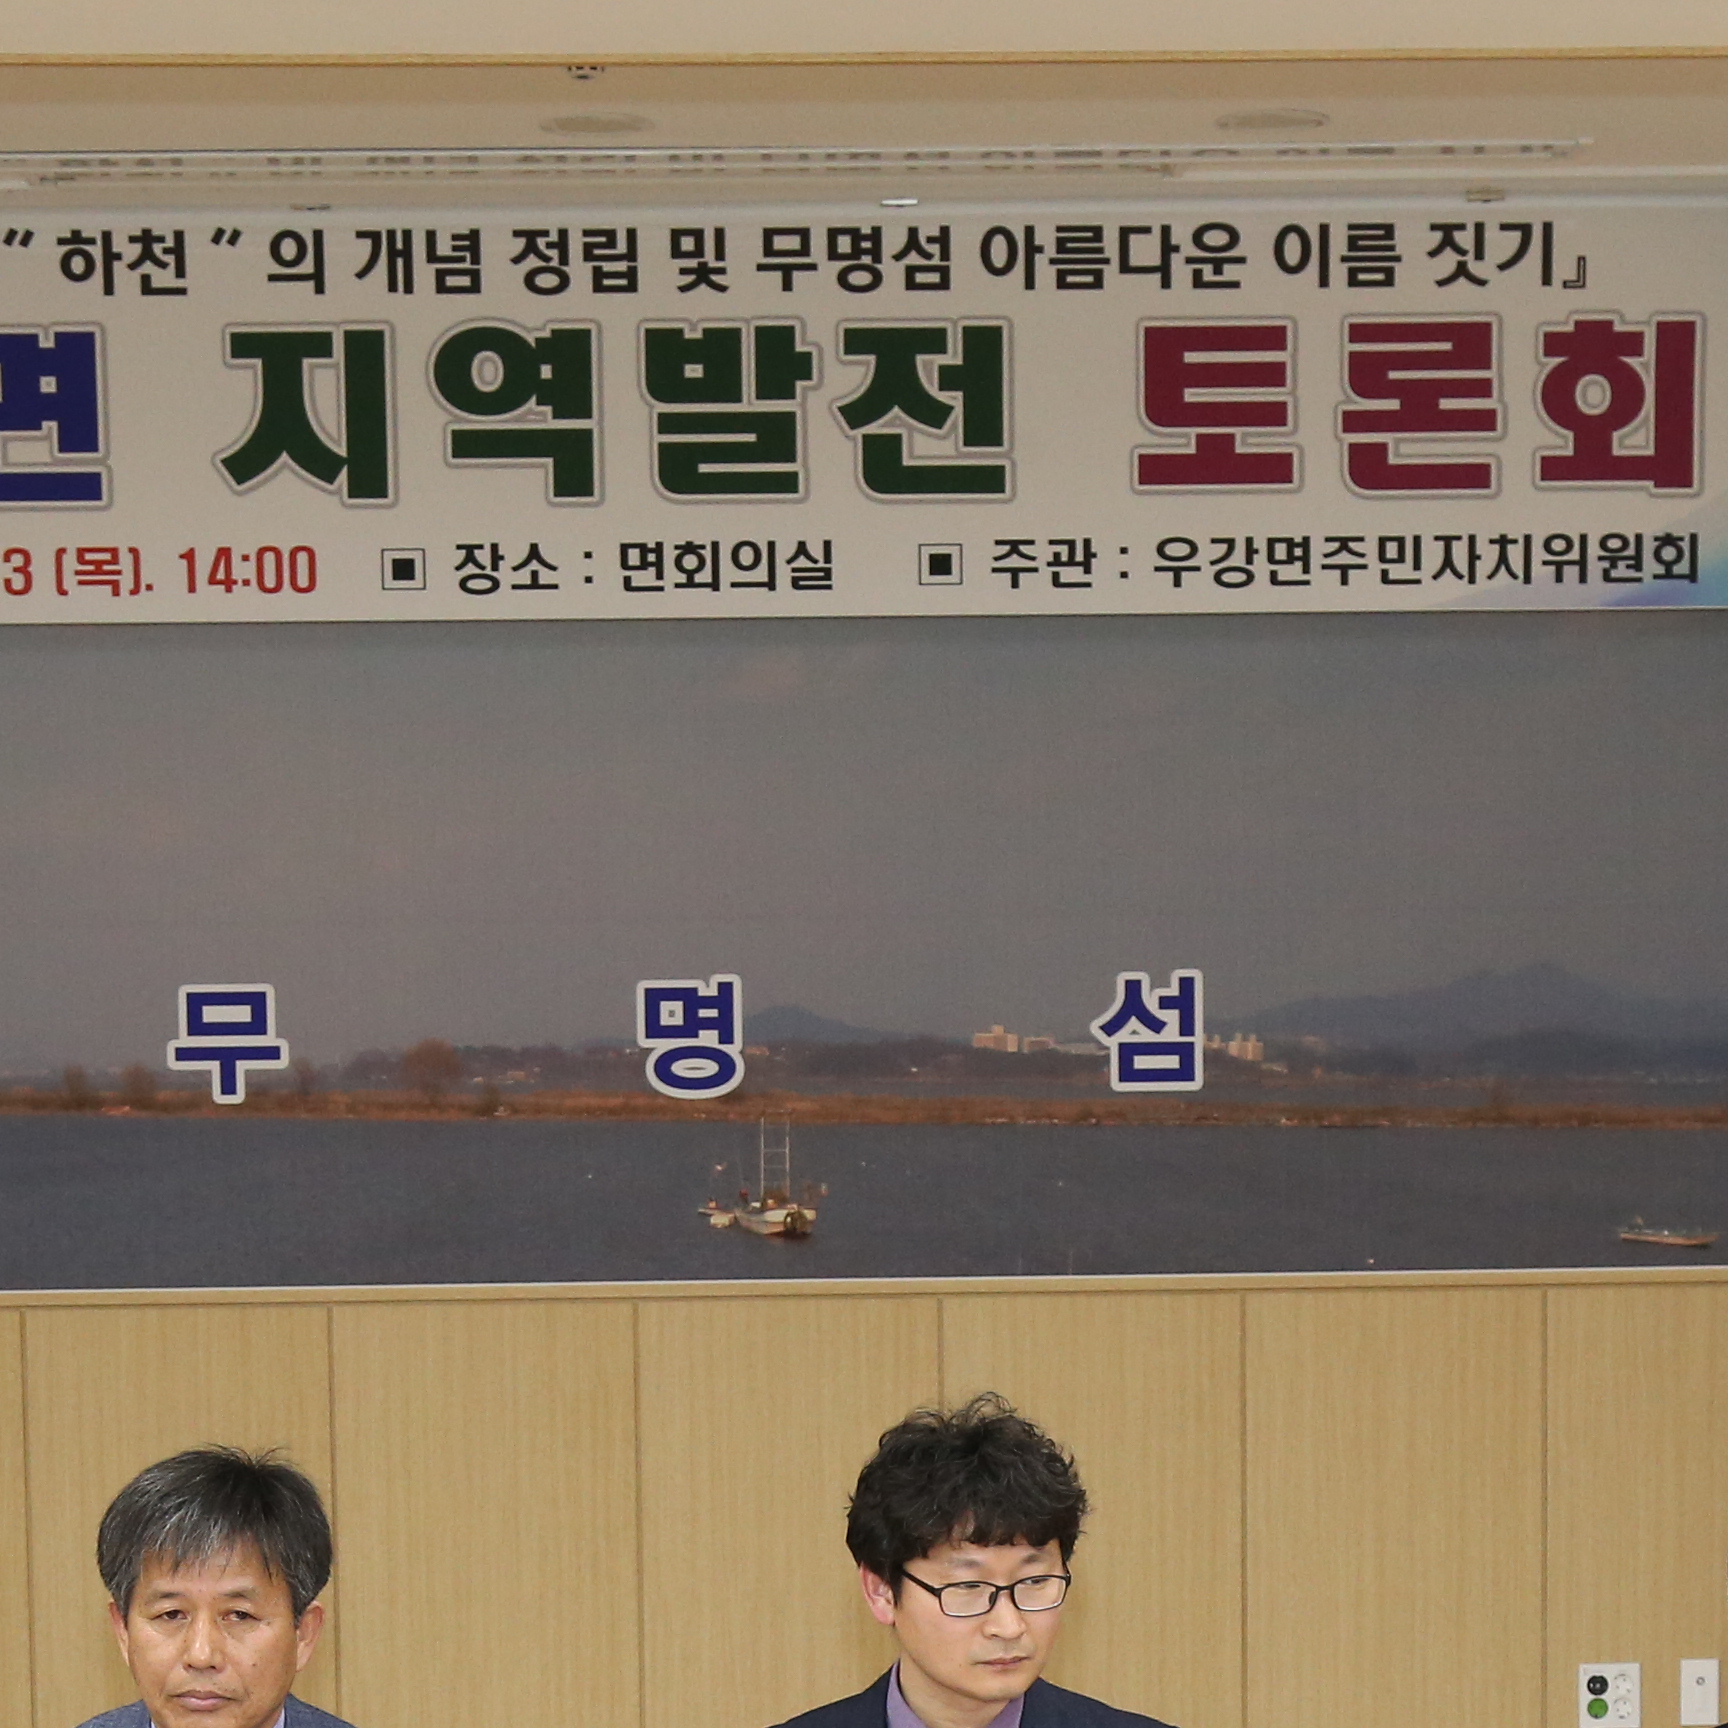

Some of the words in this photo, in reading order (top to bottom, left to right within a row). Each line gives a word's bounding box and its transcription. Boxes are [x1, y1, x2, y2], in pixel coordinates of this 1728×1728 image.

[354, 228, 483, 296] 개념
[509, 227, 640, 296] 정립
[669, 227, 731, 295] 및
[756, 225, 952, 294] 무명섬
[979, 222, 1248, 292] 아름다운
[1273, 222, 1403, 290] 이름
[1132, 315, 1702, 497] 토론회
[178, 544, 318, 595] 14:00
[618, 538, 834, 594] 면회의실
[1153, 531, 1700, 590] 우강면주민자치위원회
